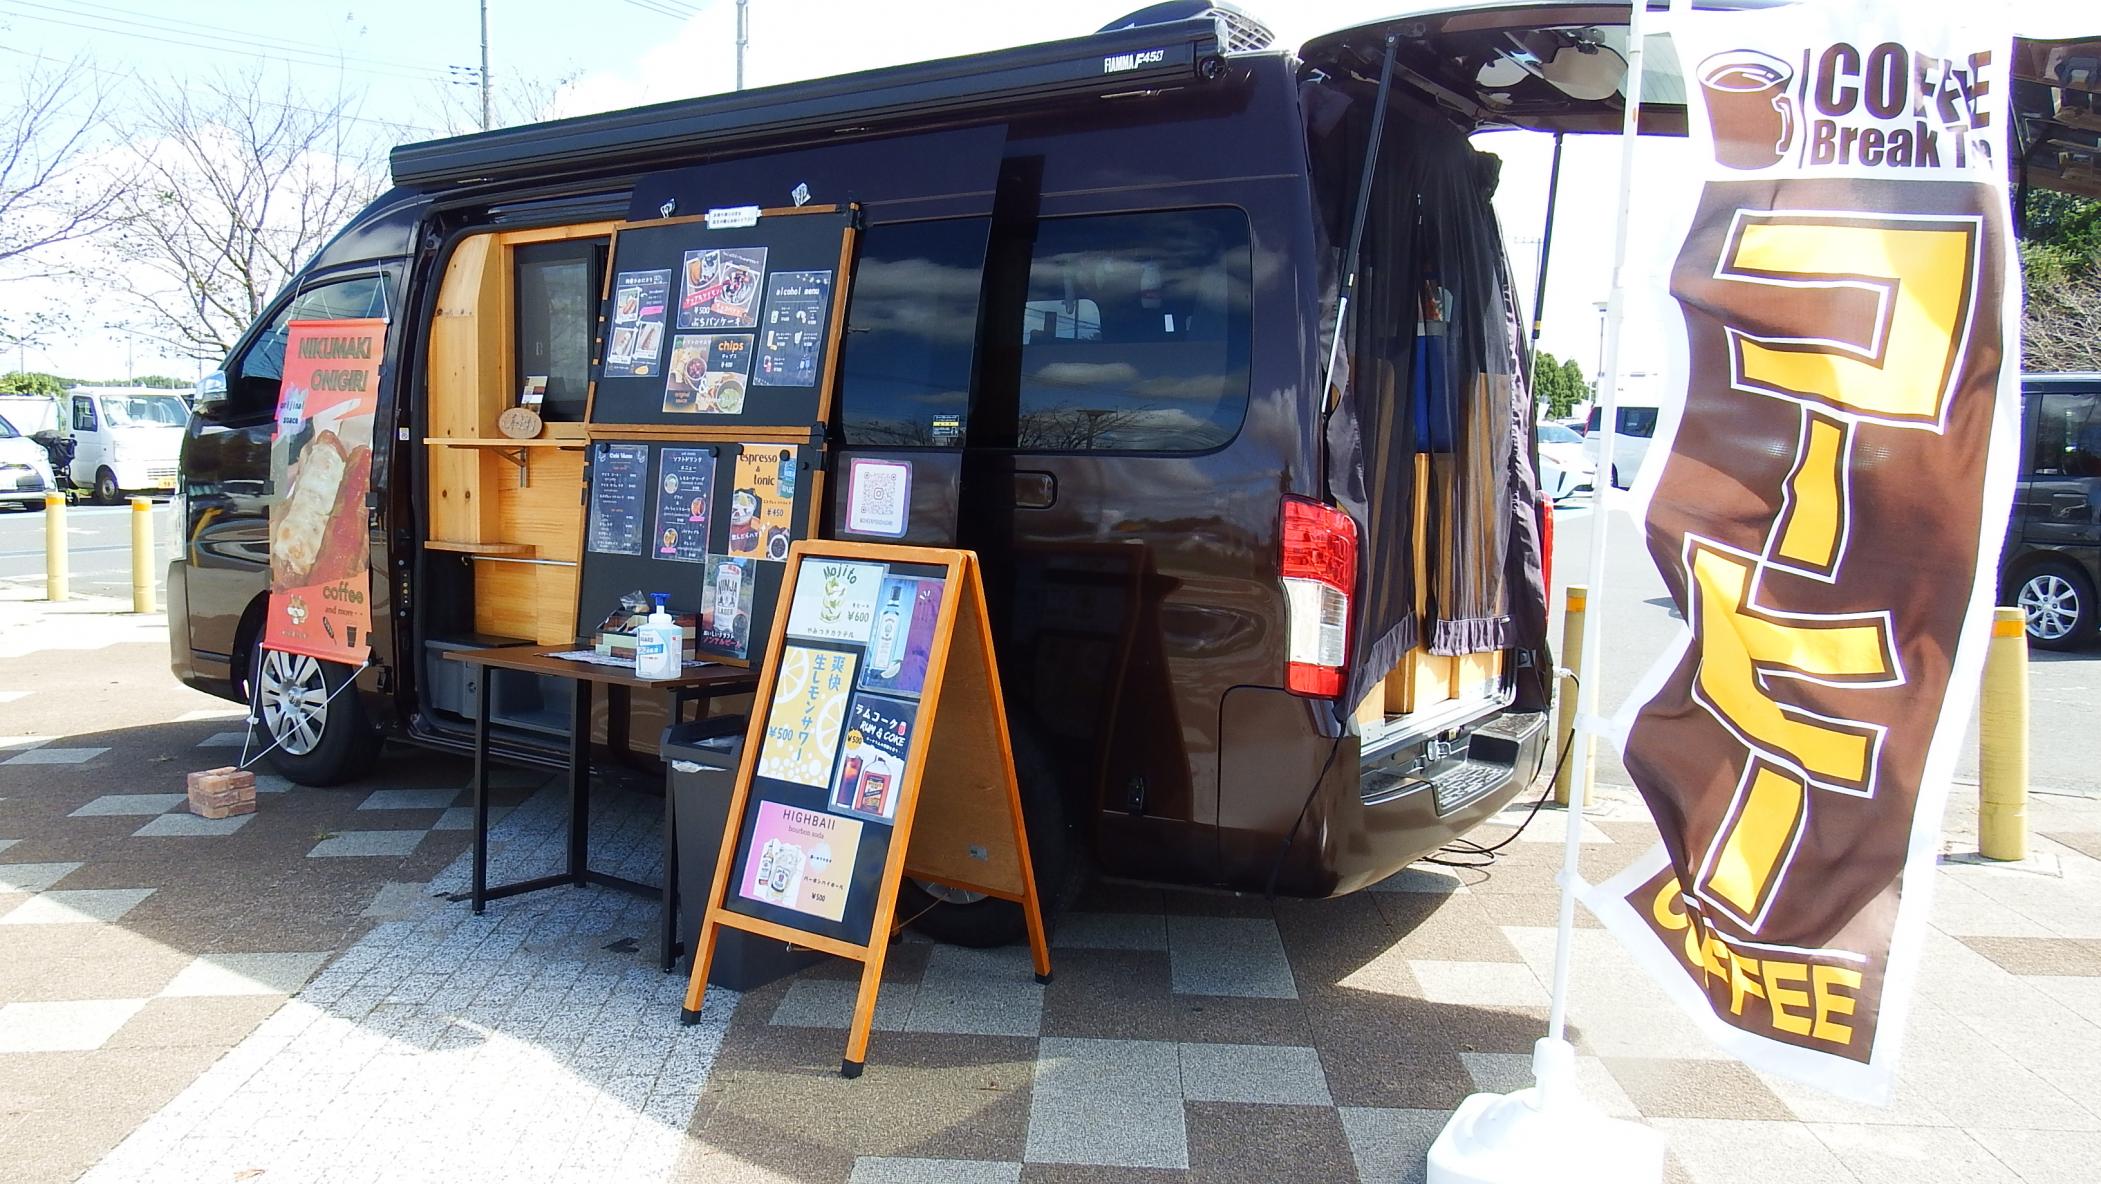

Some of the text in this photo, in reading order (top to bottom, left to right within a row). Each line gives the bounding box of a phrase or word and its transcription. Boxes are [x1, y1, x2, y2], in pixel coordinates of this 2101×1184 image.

[1810, 119, 1941, 168] Break
[298, 337, 372, 359] NIKUMAKI
[718, 340, 744, 353] chips
[311, 369, 369, 392] ONIGIRI
[740, 453, 778, 466] espresso
[754, 474, 775, 486] tonic
[823, 565, 857, 585] Mojito
[1684, 208, 1984, 936] コーヒー
[322, 581, 364, 604] coffee
[718, 579, 737, 592] NINJA
[325, 606, 337, 615] and
[848, 611, 869, 623] ¥600
[828, 656, 846, 691] 爽快
[796, 654, 827, 761] 生レモンサワー
[855, 703, 898, 730] ラムコーク
[768, 726, 793, 741] ¥500
[860, 720, 877, 735] RUM
[876, 728, 883, 740] &
[884, 731, 906, 747] COKE
[811, 831, 825, 840] soda
[811, 892, 826, 902] ¥500
